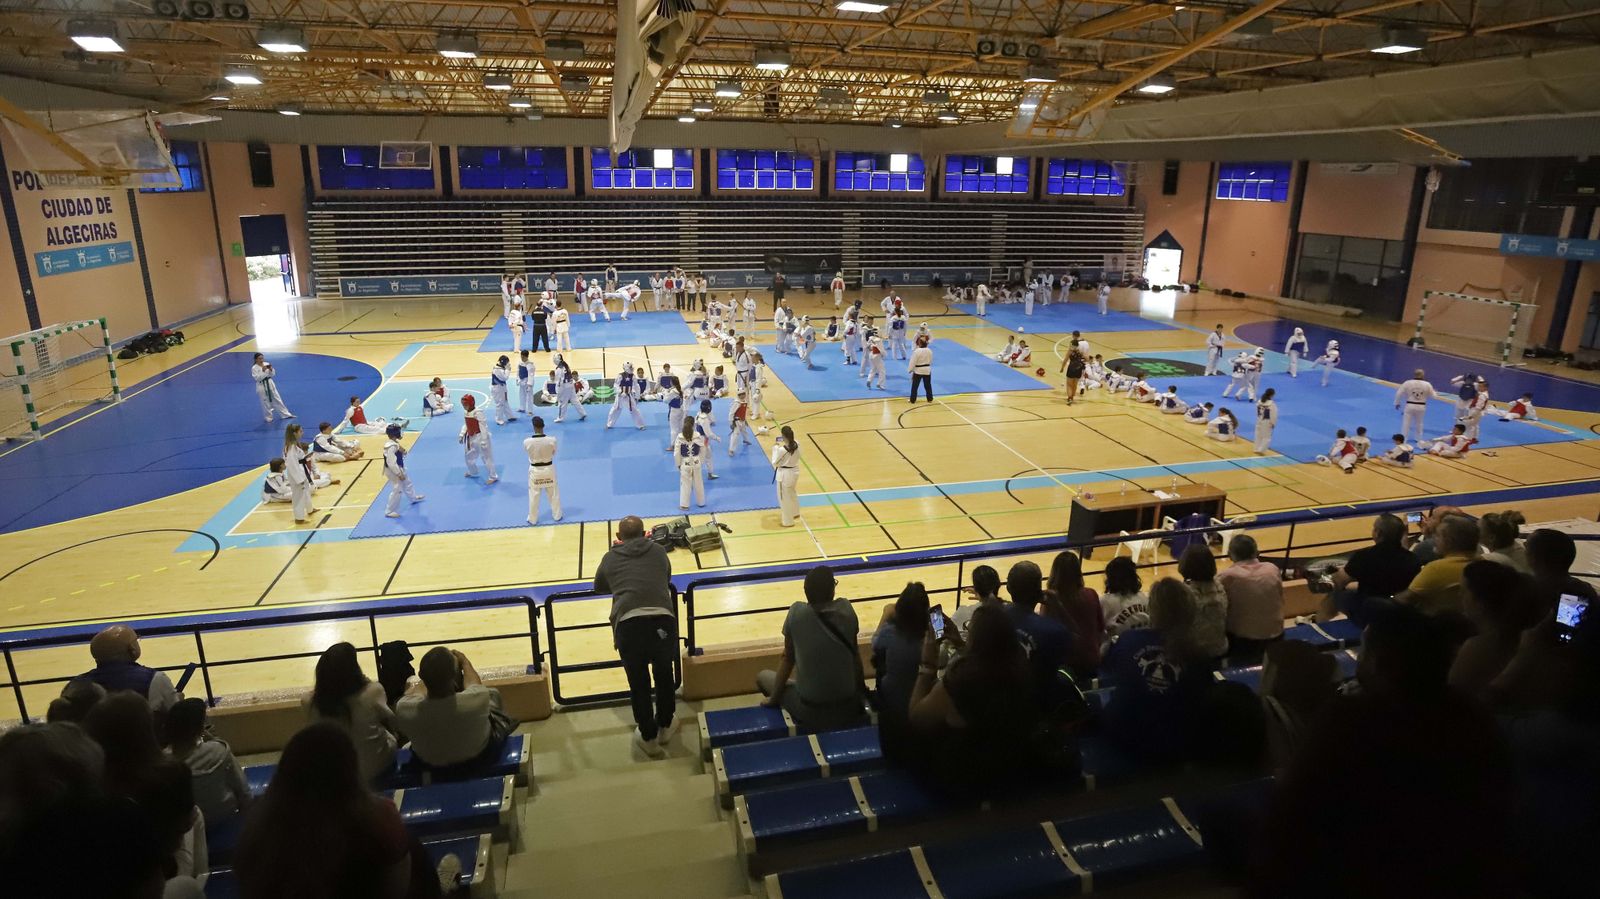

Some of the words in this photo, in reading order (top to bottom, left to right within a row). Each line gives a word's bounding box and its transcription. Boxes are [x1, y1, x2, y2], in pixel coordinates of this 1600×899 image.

[41, 197, 94, 219] CIUDAD
[96, 196, 113, 214] DE
[47, 222, 118, 246] ALGECIRAS
